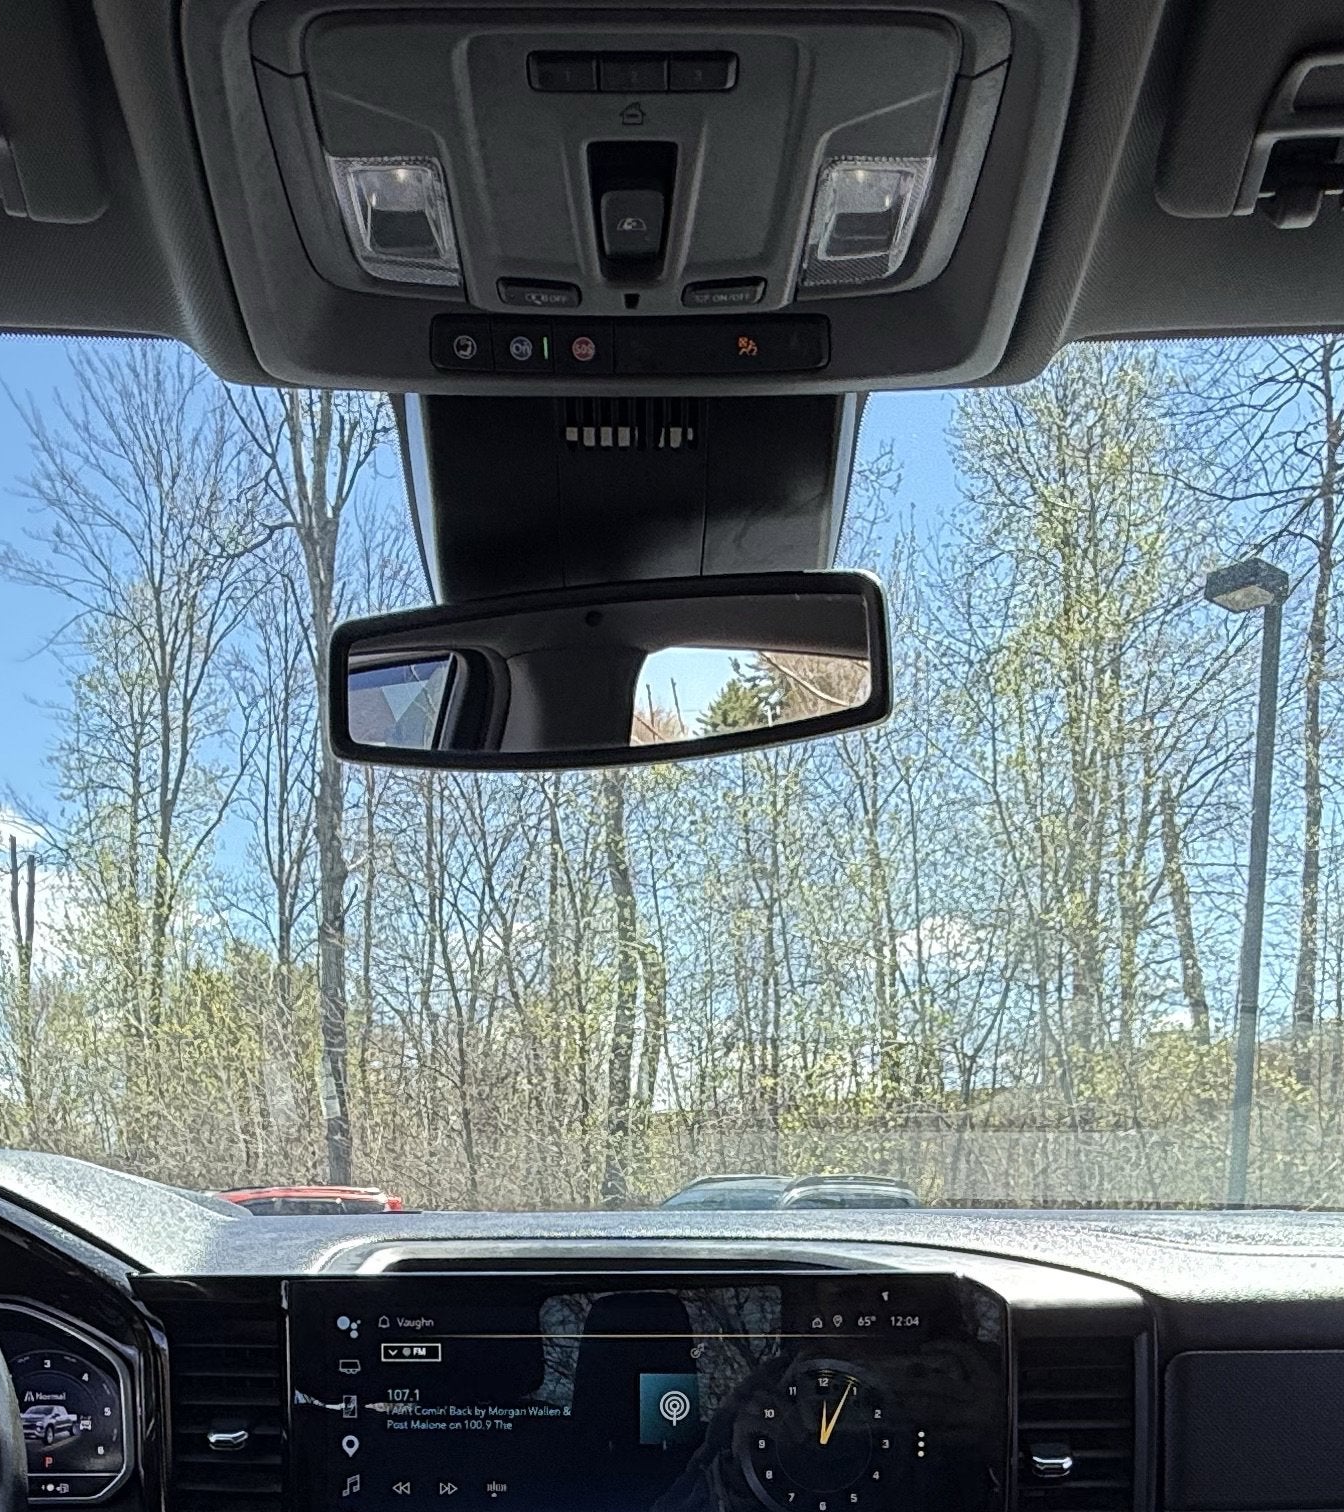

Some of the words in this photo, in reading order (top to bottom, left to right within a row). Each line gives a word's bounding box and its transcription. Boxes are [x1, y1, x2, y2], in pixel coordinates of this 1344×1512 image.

[396, 1317, 435, 1330] Vaughn
[890, 1316, 920, 1327] 12:04
[413, 1347, 427, 1357] FM
[43, 1359, 52, 1369] 3
[35, 1392, 67, 1401] Normal
[386, 1389, 421, 1402] 107.1
[449, 1406, 473, 1417] Back
[474, 1406, 487, 1419] by
[488, 1406, 527, 1419] Morgan
[527, 1406, 562, 1417] Wallen
[386, 1420, 409, 1431] Post
[410, 1420, 447, 1430] Malone
[448, 1422, 463, 1430] on
[464, 1420, 493, 1430] 100.9
[494, 1420, 513, 1430] The
[44, 1456, 54, 1468] P
